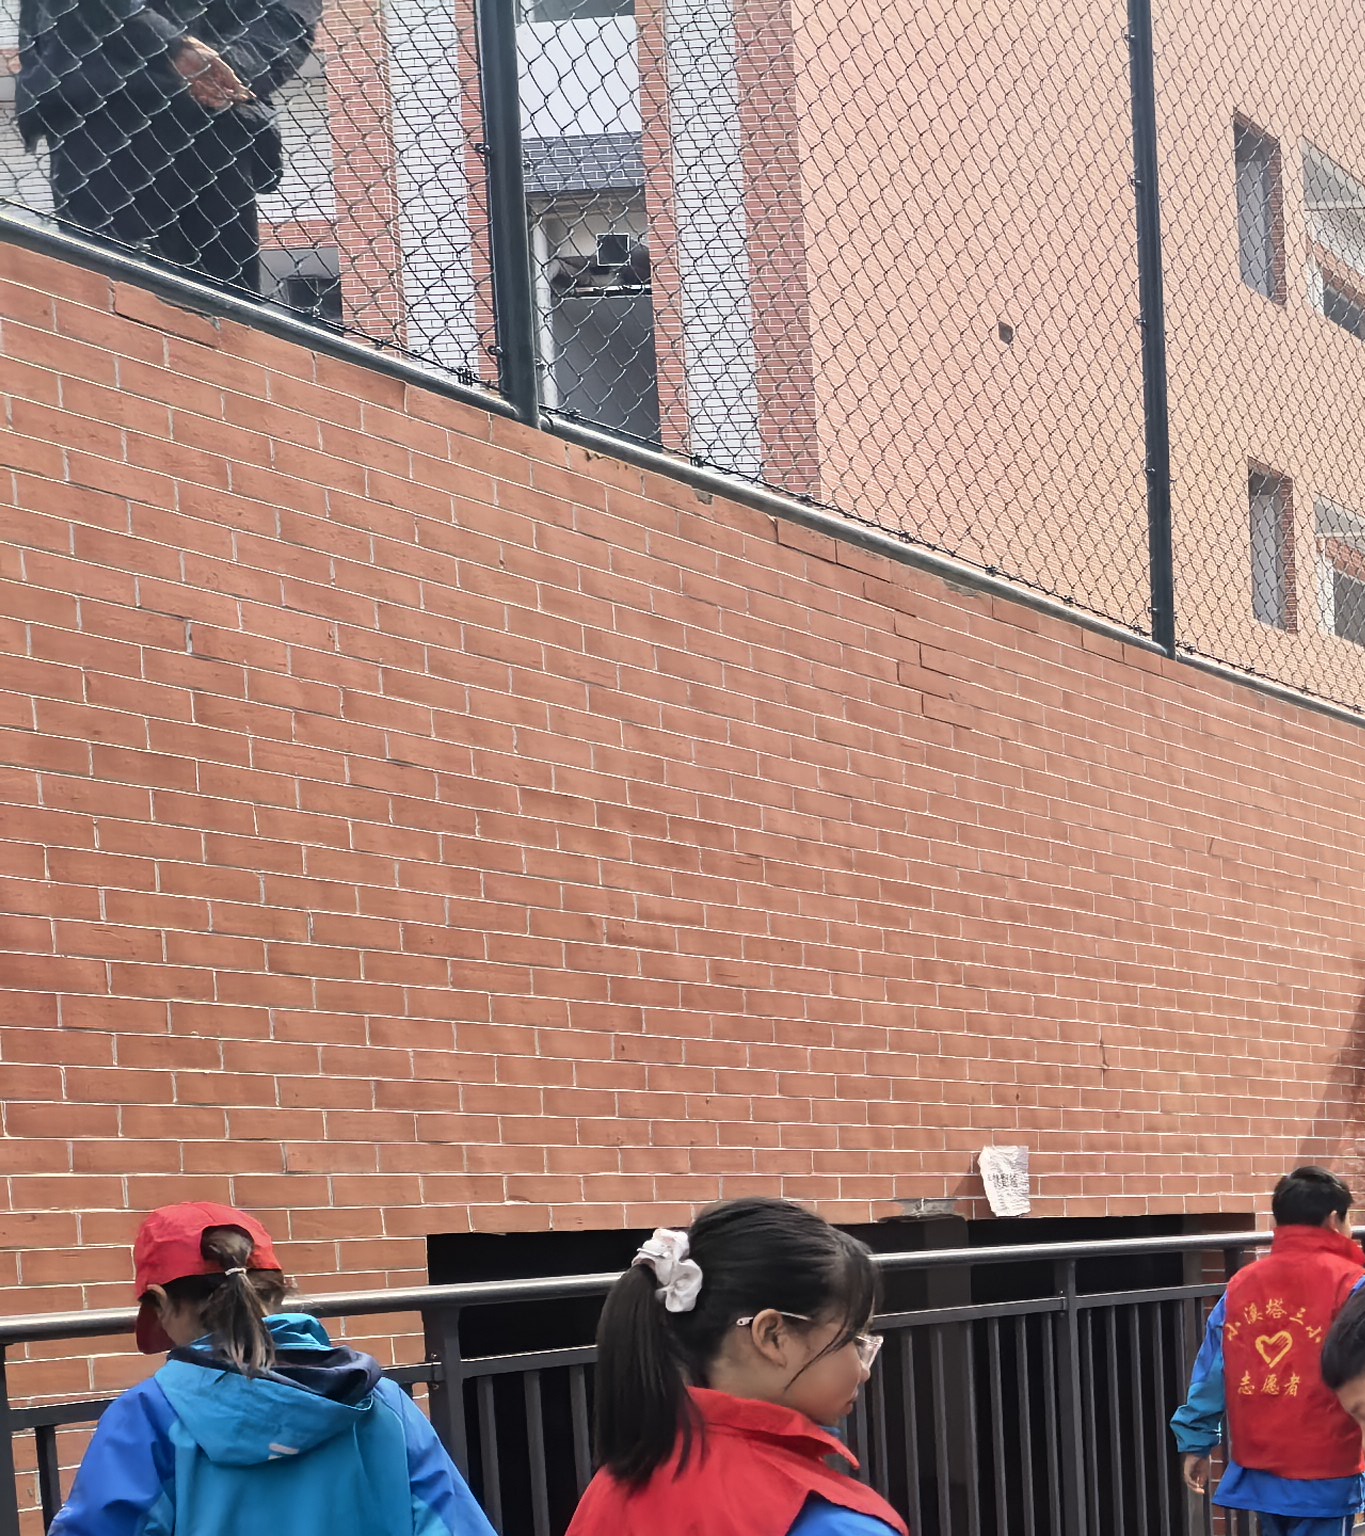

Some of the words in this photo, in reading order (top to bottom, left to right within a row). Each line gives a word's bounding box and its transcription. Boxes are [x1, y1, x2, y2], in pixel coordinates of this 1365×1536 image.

[1225, 1298, 1322, 1343] 小溪塔三小
[1238, 1370, 1300, 1397] 志愿者
